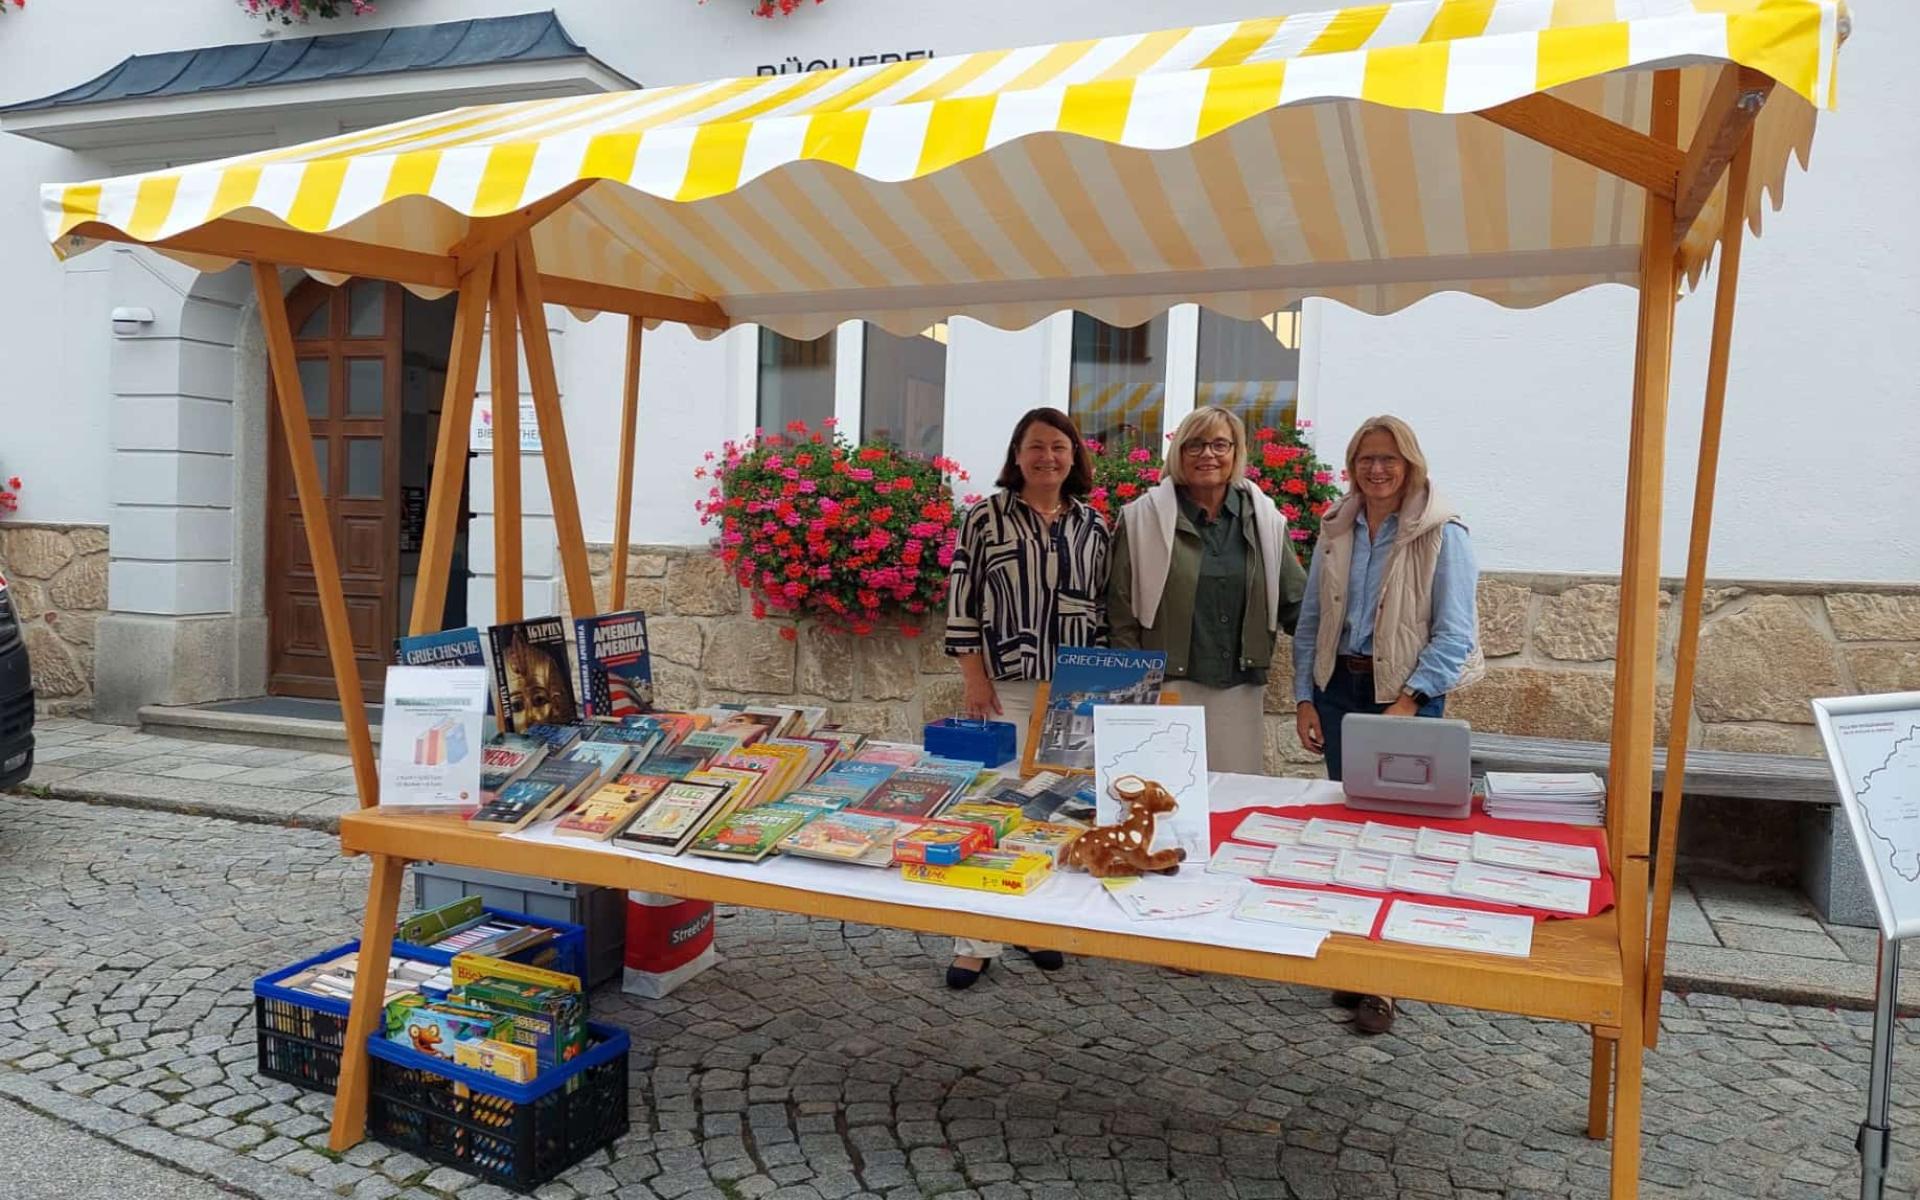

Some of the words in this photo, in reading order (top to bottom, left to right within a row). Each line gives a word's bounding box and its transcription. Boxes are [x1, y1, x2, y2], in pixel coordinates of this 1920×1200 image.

[593, 621, 644, 643] AMERIKA
[407, 641, 479, 665] GRIECHISCHE
[595, 637, 646, 659] AMERIKA
[1058, 654, 1164, 670] GRIECHENLAND
[672, 919, 700, 944] Street
